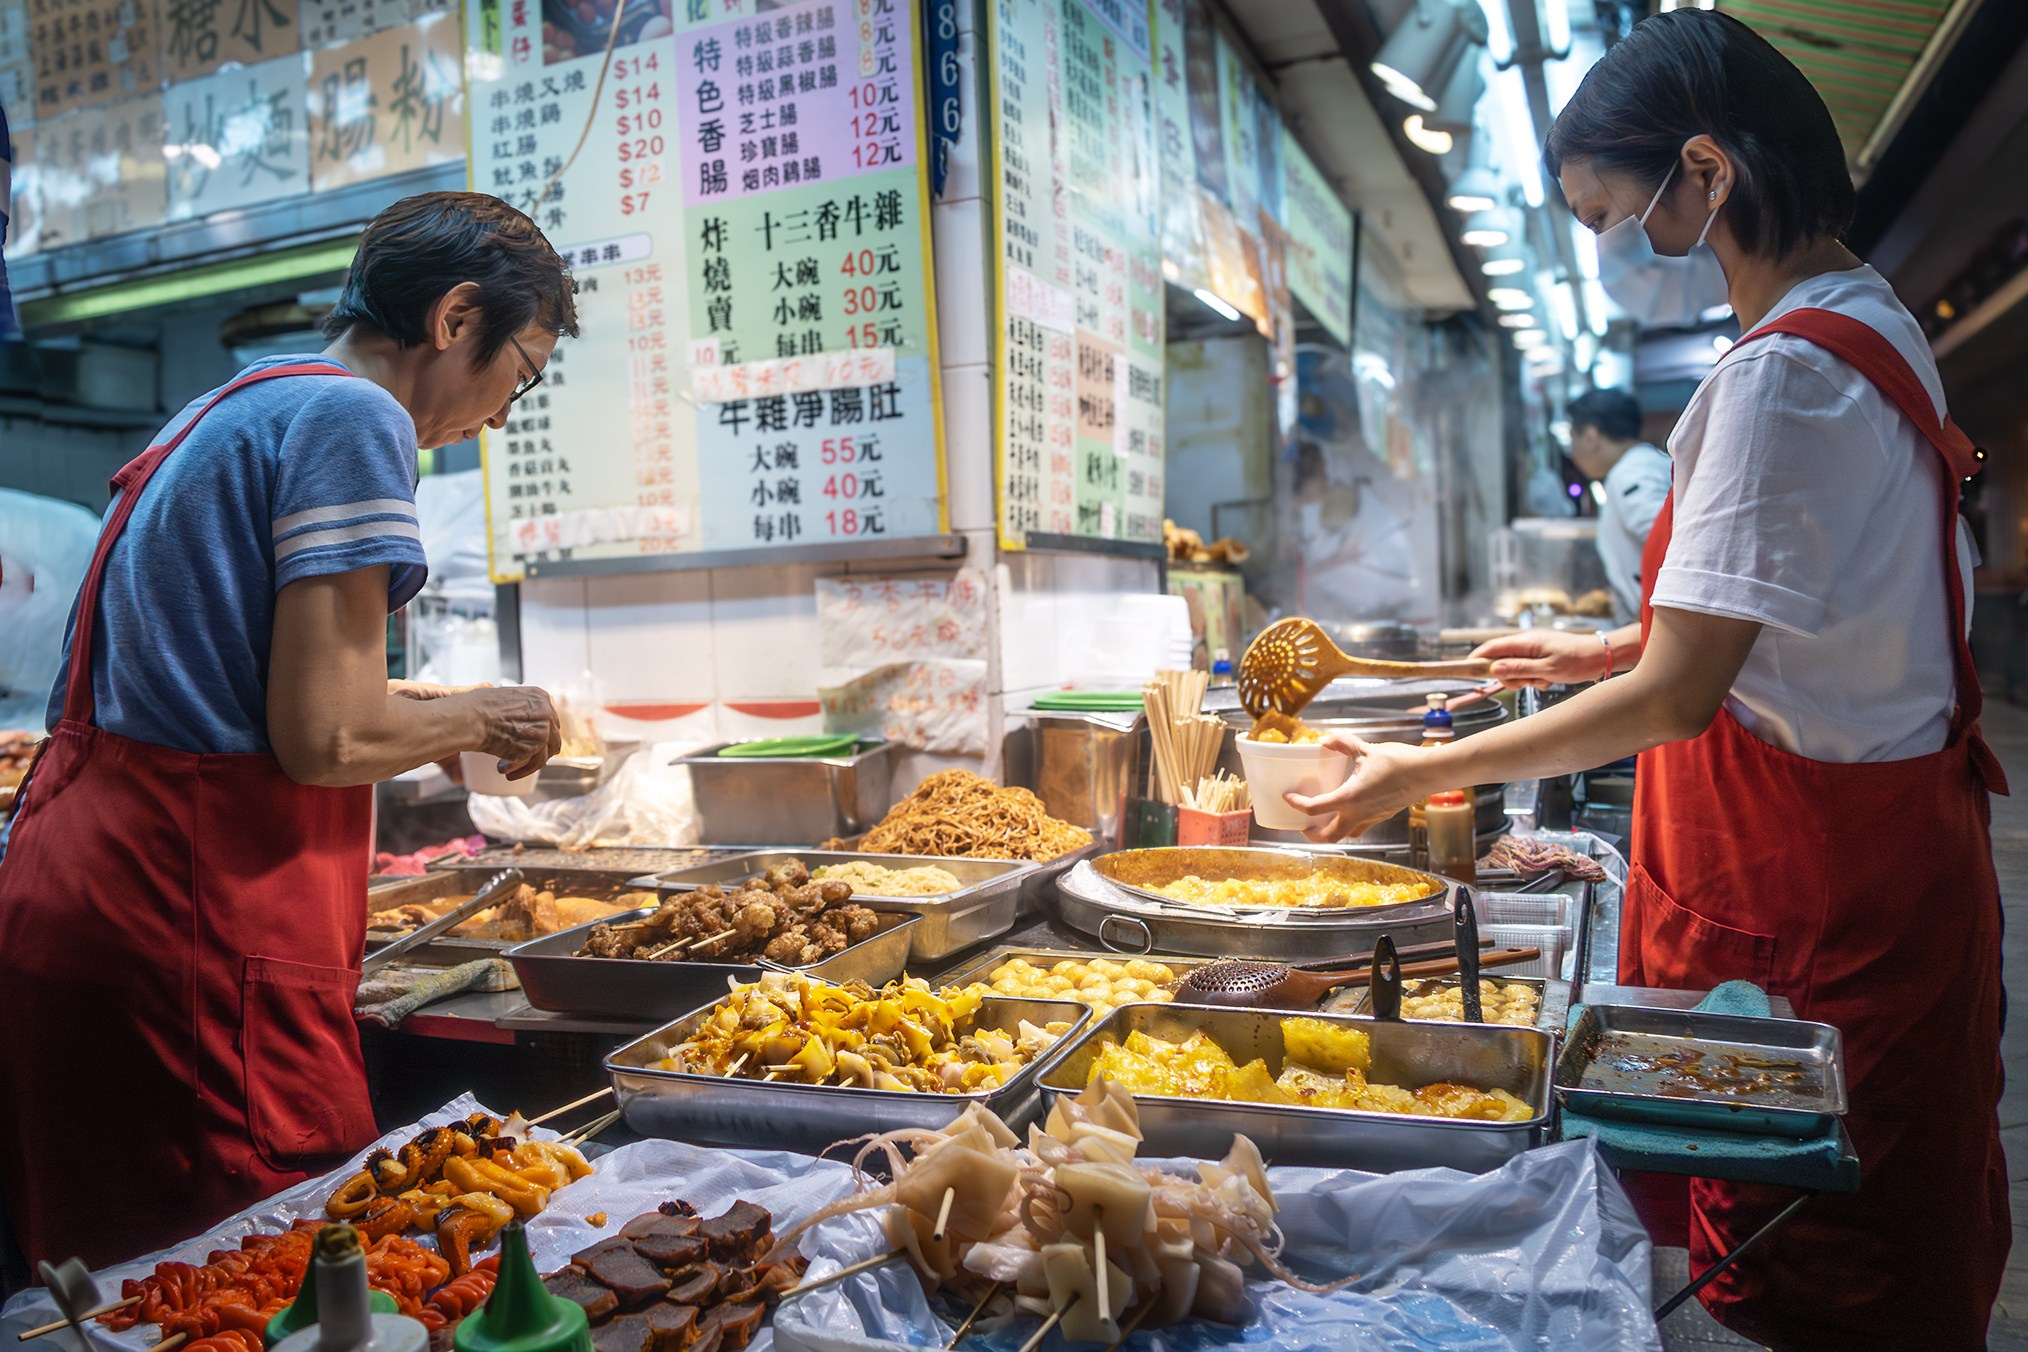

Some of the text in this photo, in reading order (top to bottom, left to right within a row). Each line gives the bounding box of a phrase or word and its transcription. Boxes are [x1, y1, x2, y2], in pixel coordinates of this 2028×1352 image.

[861, 17, 895, 46] 8元
[614, 52, 659, 80] $14
[736, 36, 836, 78] 特級蒜香腸
[615, 82, 660, 109] $14
[737, 64, 838, 107] 特級黑椒腸
[849, 77, 899, 109] 10元
[318, 45, 456, 162] 腸粉
[693, 37, 728, 196] 特色香腸
[739, 103, 798, 136] 芝士腸
[616, 109, 662, 136] $10
[850, 107, 901, 140] 12元
[618, 136, 664, 163] $20
[740, 132, 799, 164] 珍寶腸
[852, 137, 902, 169] 12元
[620, 192, 651, 216] $7
[754, 189, 904, 252] 十三香牛雜
[624, 263, 663, 285] 13元
[701, 217, 733, 334] 炸燒賣
[770, 256, 820, 293] 大碗
[840, 244, 901, 279] 40元
[772, 293, 823, 327] 小碗
[843, 280, 904, 316] 30元
[628, 331, 668, 352] 10元
[775, 328, 823, 358] 每串
[846, 318, 904, 349] 15元
[719, 381, 905, 437] 牛雜淨腸肚
[750, 442, 800, 473] 大碗
[821, 433, 882, 465] 55元
[751, 477, 802, 508] 小碗
[823, 469, 885, 499] 40元
[754, 512, 802, 542] 每串
[825, 505, 886, 536] 18元
